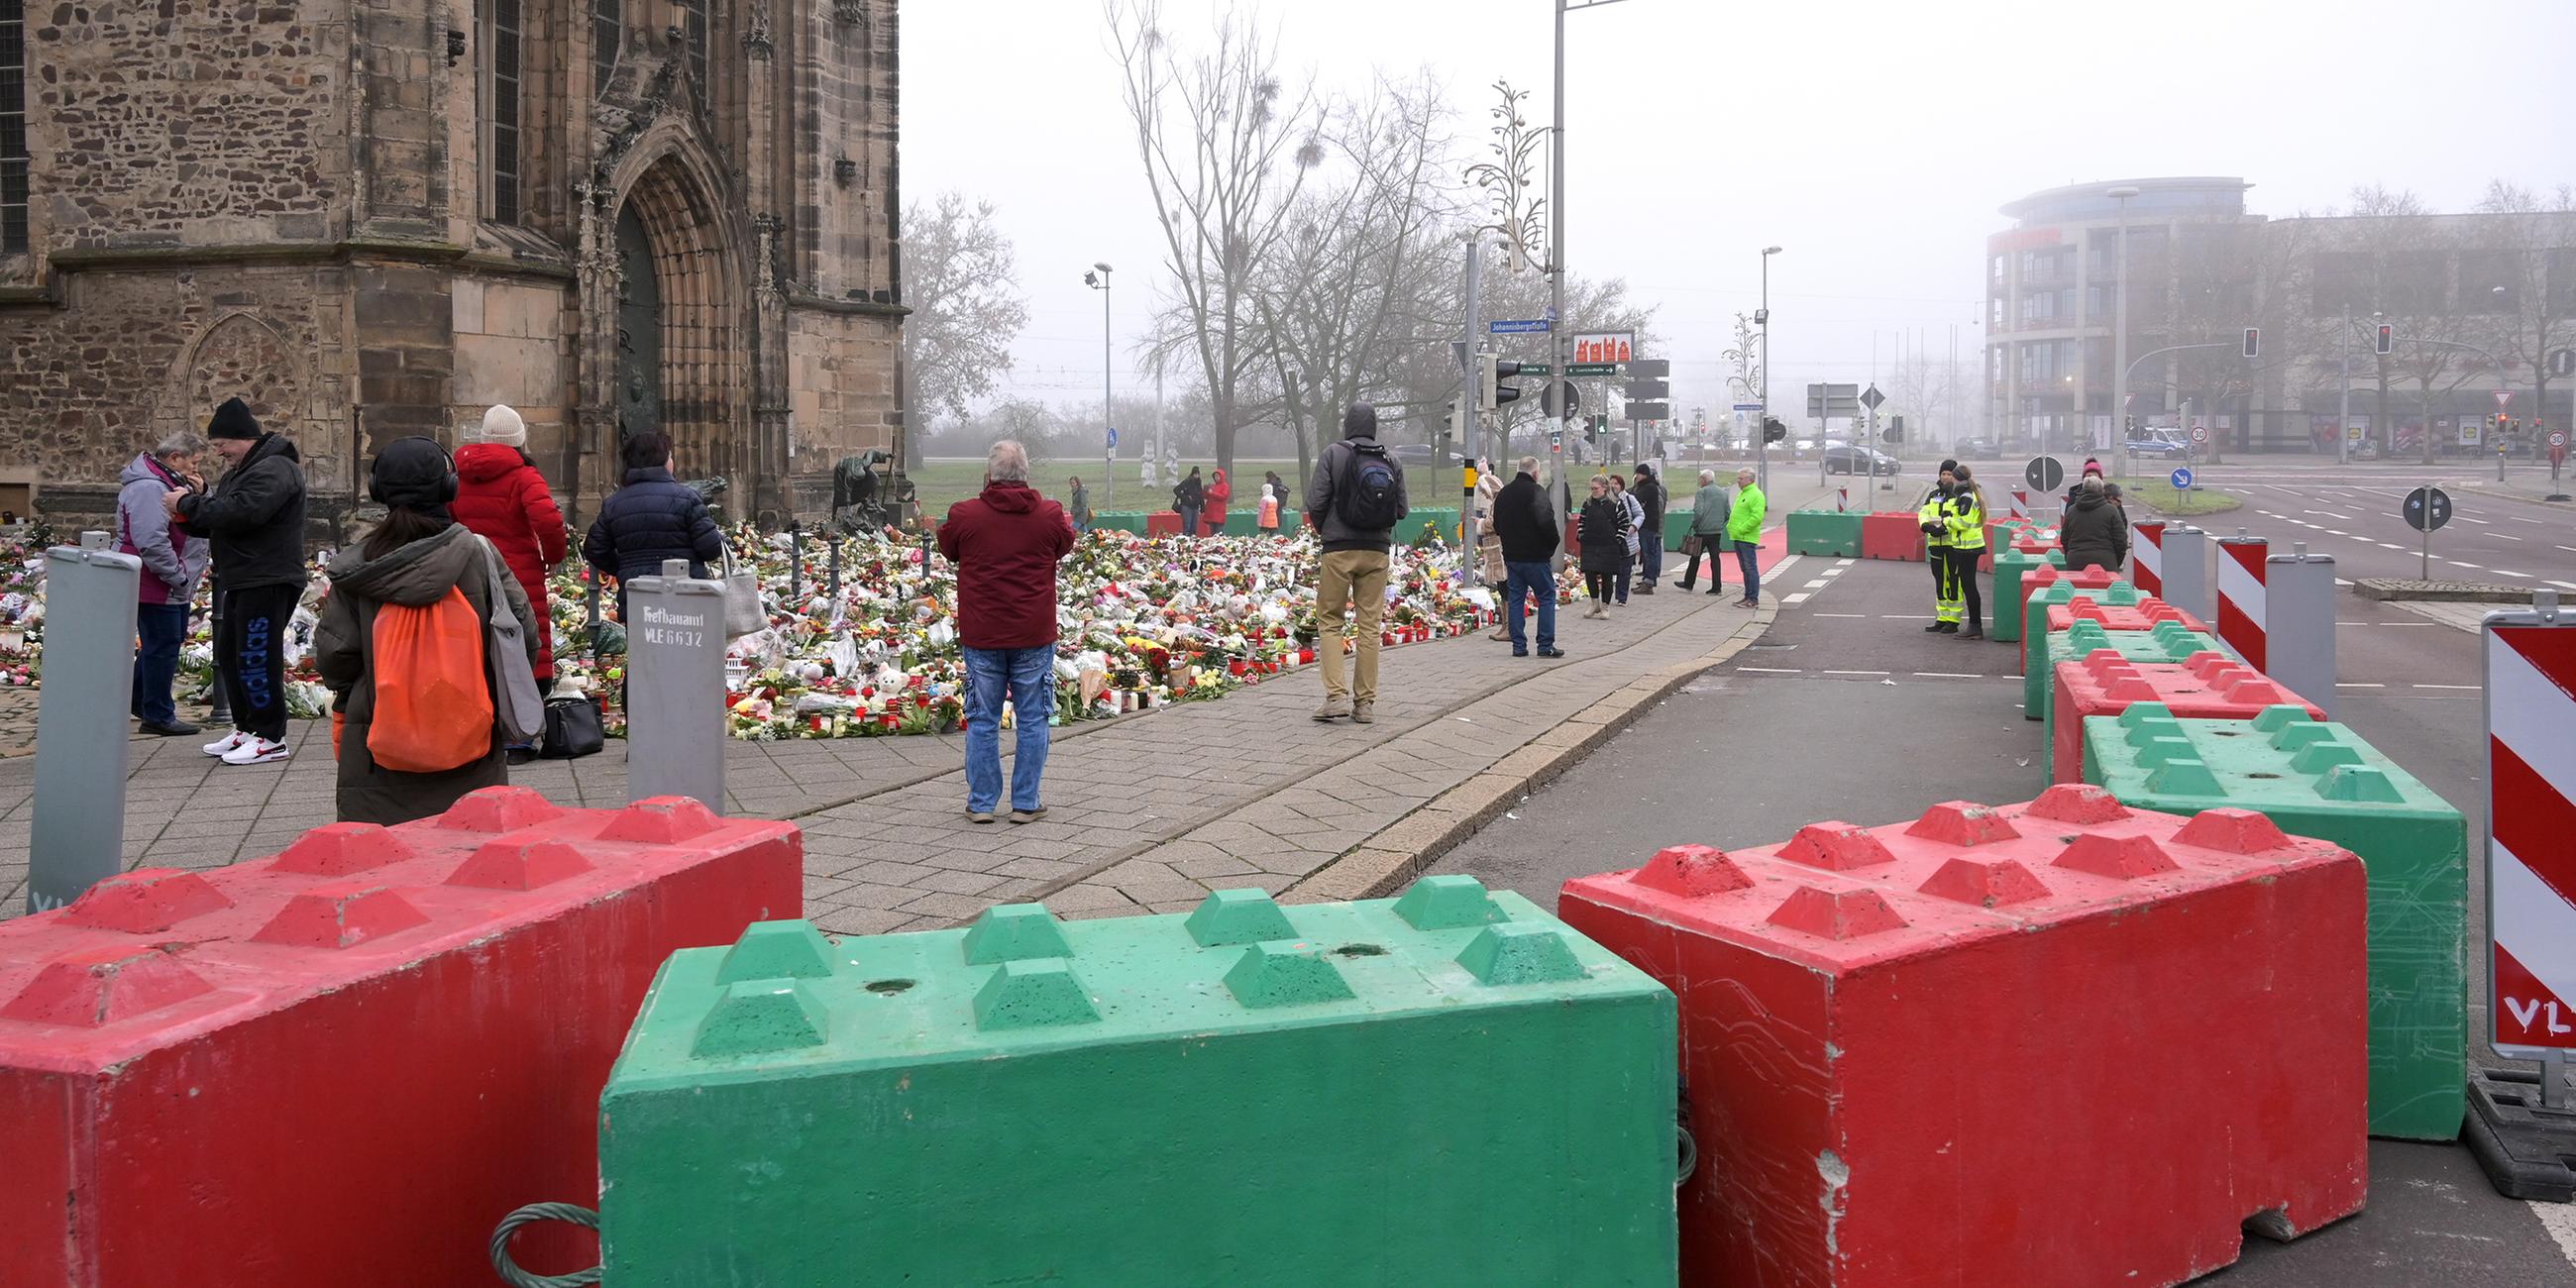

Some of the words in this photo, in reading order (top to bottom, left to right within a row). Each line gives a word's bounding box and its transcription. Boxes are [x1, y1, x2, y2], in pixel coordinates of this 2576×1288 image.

[2194, 430, 2204, 439] 30
[2551, 435, 2563, 444] 30
[645, 627, 664, 644] VLE
[239, 617, 270, 707] adidas
